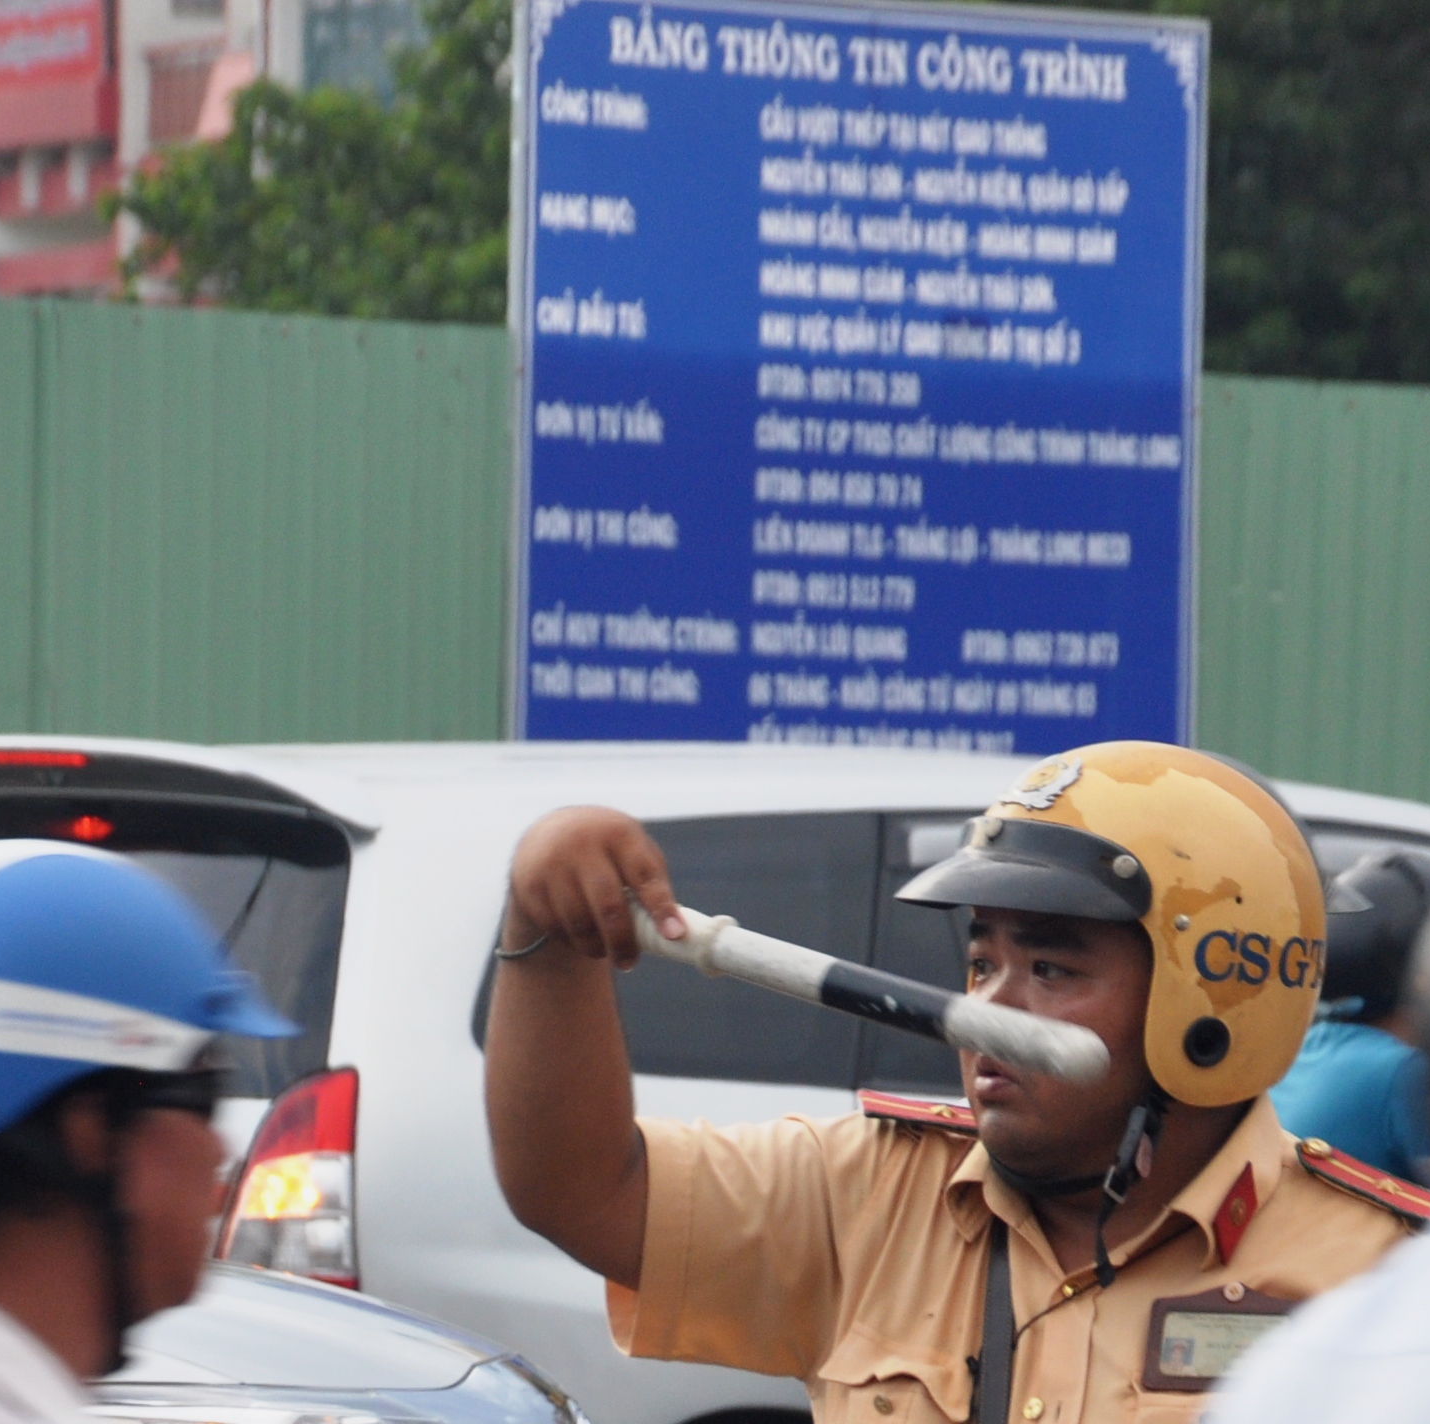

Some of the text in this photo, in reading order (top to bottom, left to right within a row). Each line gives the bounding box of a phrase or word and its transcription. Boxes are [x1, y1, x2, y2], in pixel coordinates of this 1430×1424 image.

[610, 4, 1126, 103] BẢNG THÔNG TIN CÔNG TRÌNH
